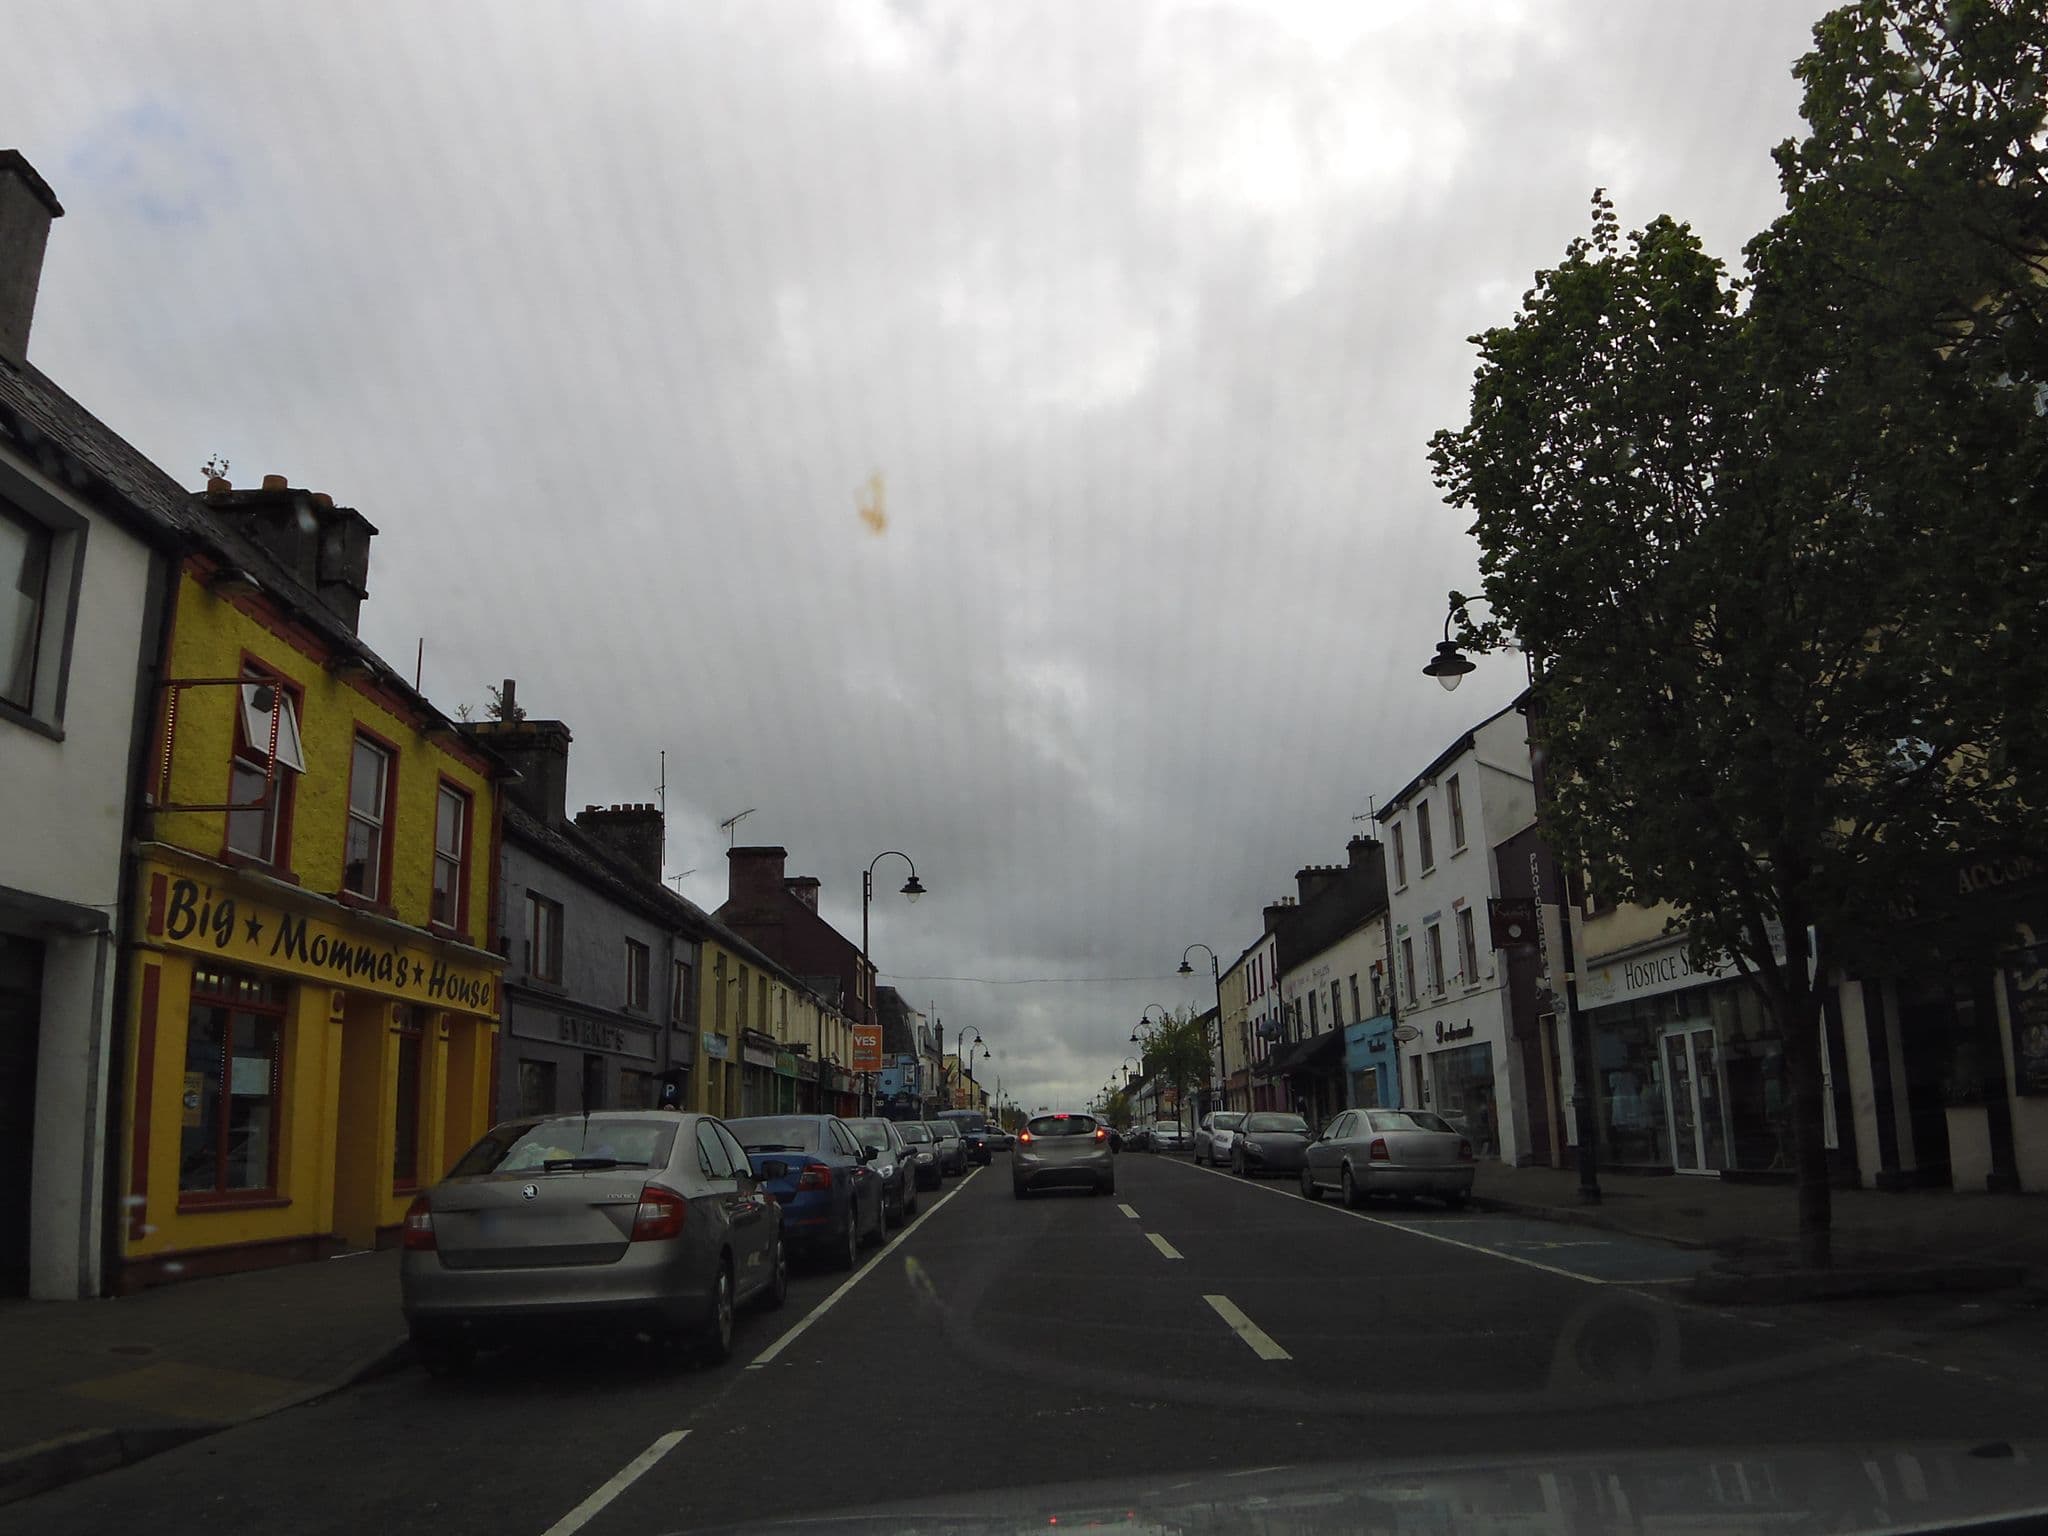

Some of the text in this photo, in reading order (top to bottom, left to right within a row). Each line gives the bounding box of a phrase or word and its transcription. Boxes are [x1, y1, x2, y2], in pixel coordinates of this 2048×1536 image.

[166, 878, 491, 1009] Big Momma's House
[1624, 956, 1678, 991] HOSPICE
[855, 1036, 876, 1047] YES
[666, 1084, 676, 1097] P
